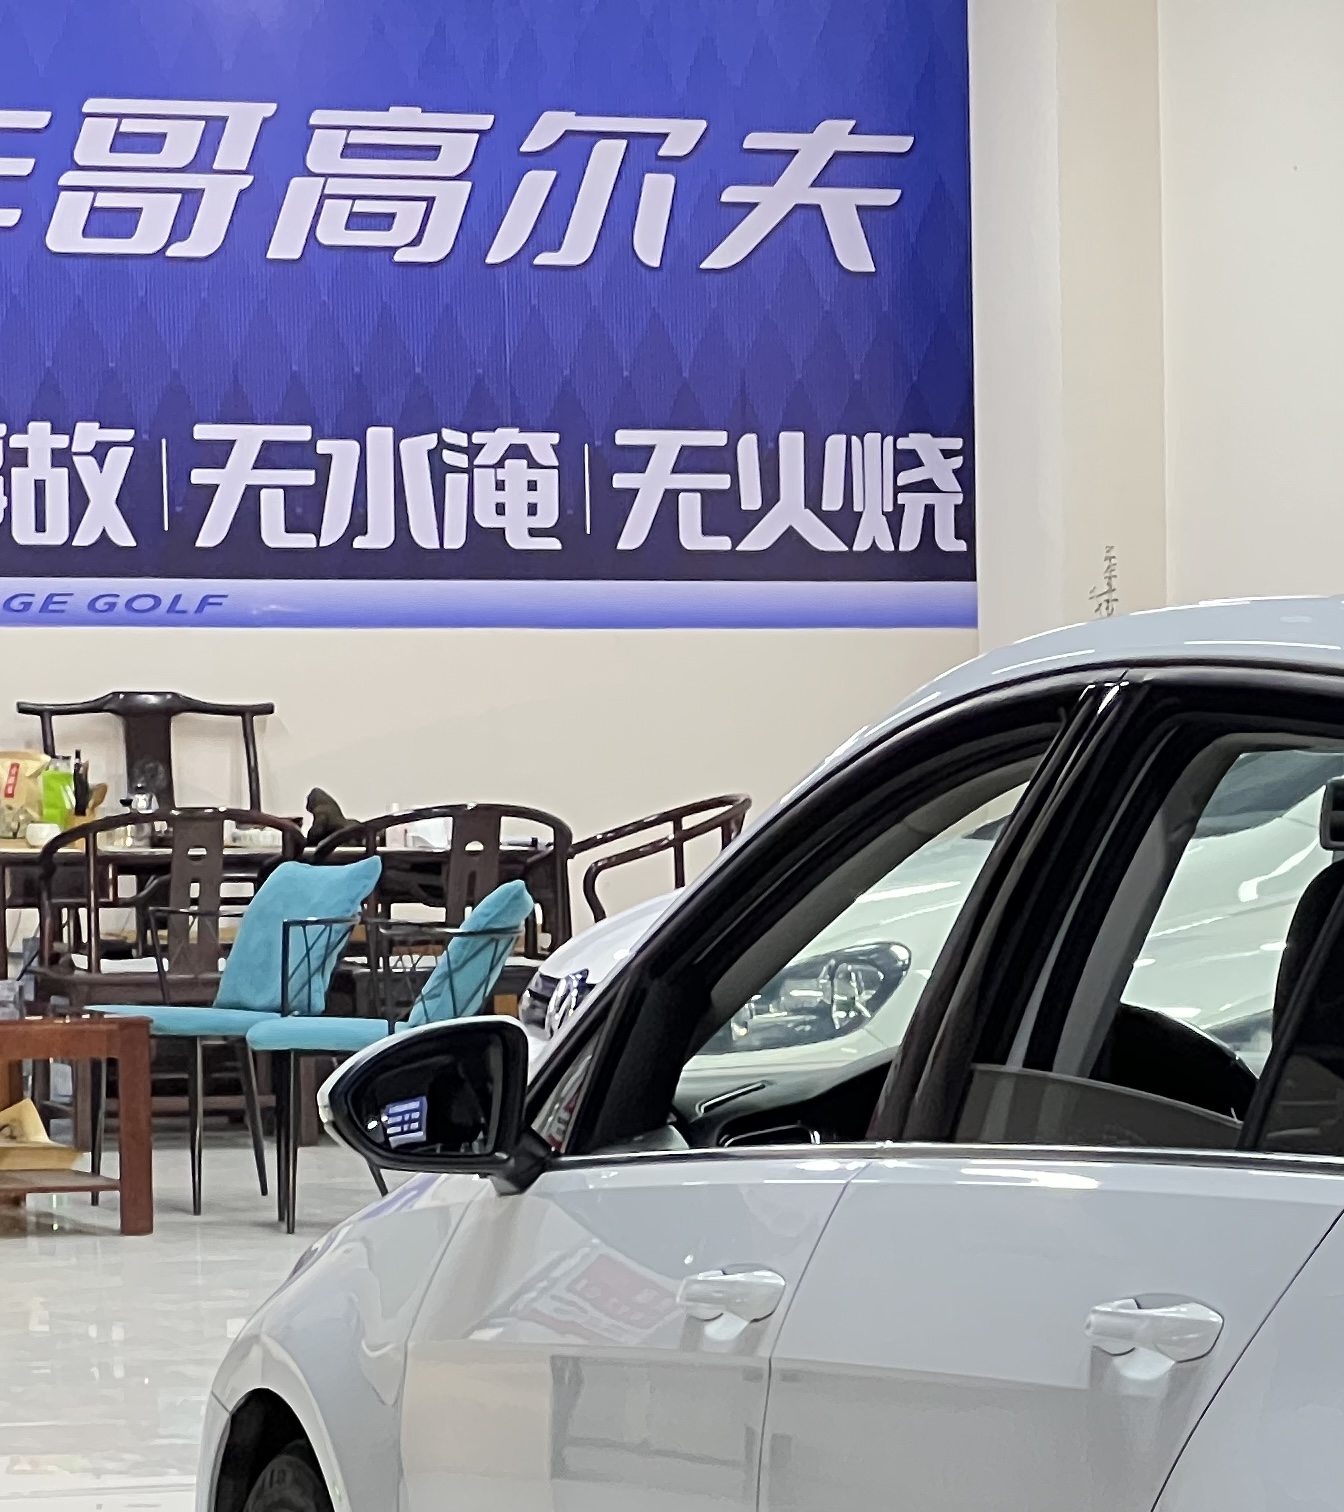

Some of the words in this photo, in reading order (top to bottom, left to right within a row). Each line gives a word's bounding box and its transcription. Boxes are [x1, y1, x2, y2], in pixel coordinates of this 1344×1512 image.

[190, 422, 563, 551] 无水淹
[612, 429, 968, 553] 无火烧
[87, 593, 229, 614] GOLF
